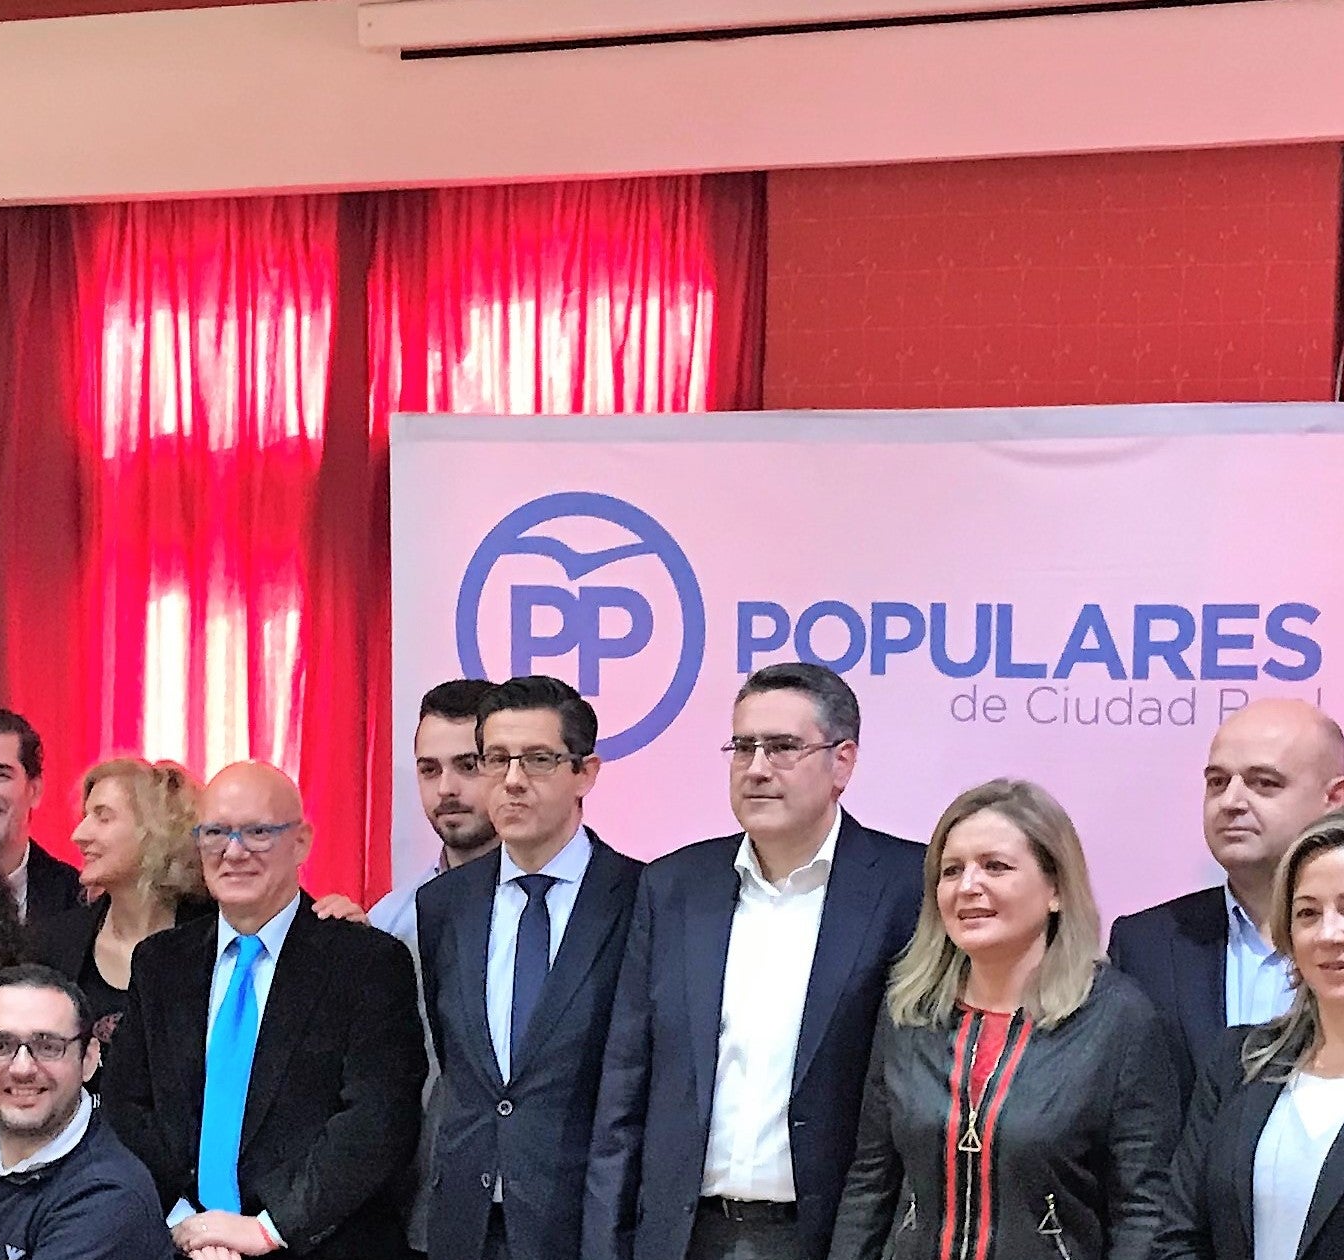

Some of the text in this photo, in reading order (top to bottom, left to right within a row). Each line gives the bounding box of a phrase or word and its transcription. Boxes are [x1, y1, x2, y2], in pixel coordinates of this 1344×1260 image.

[511, 584, 654, 697] PP
[736, 599, 1323, 682] POPULARES
[950, 684, 1322, 726] de Ciudad Rl
